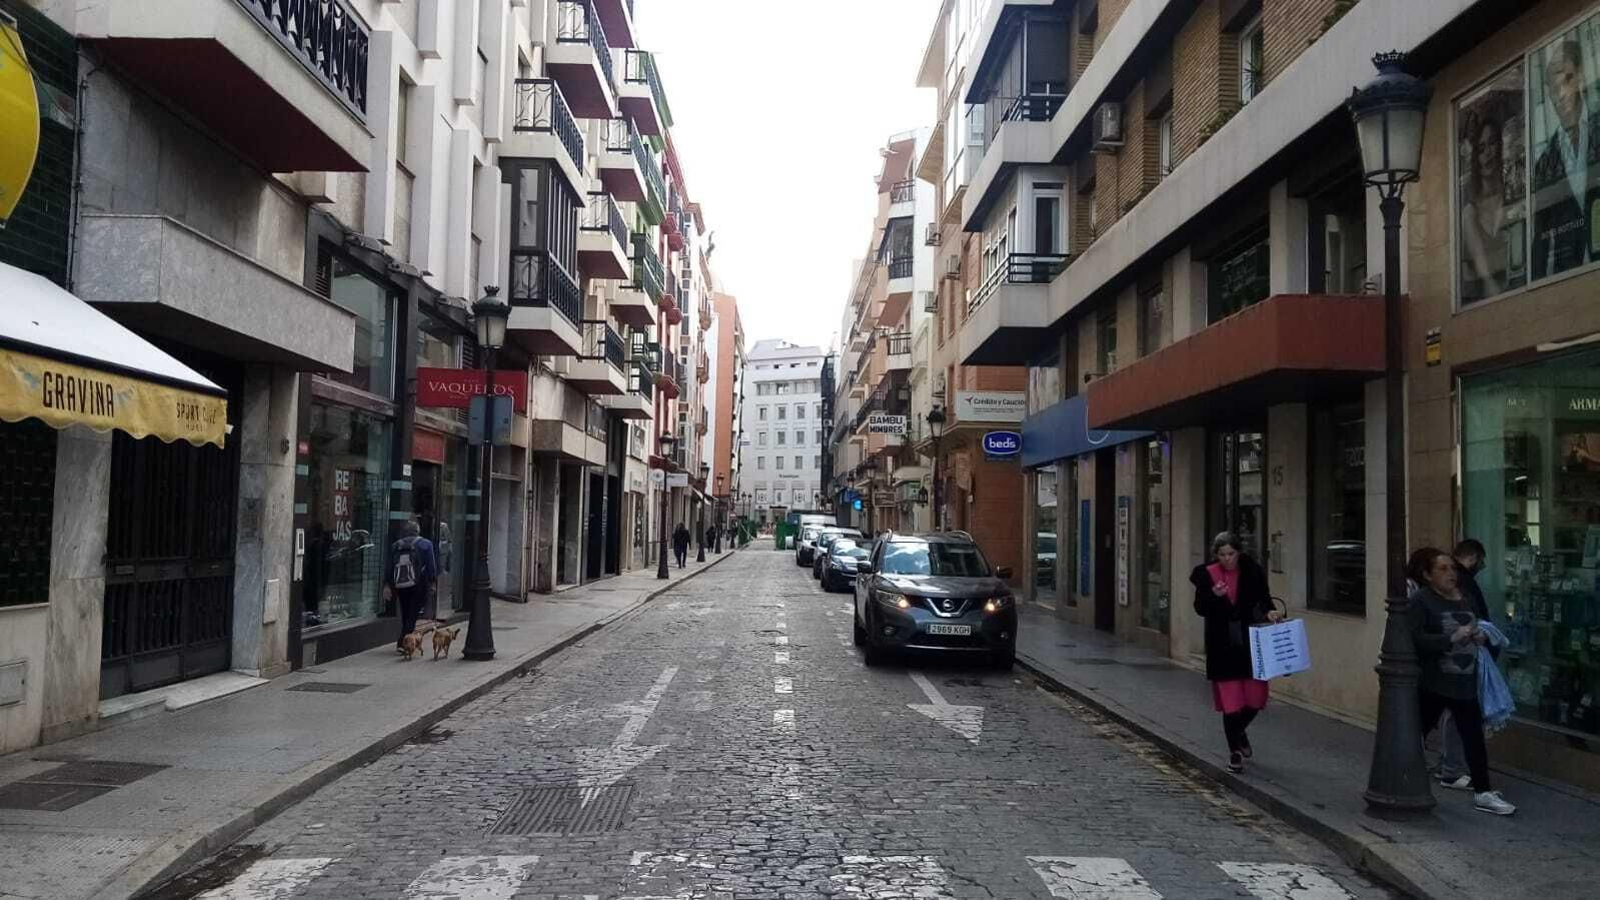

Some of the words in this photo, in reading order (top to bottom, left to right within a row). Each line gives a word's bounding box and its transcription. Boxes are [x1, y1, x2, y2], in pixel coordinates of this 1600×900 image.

[43, 371, 114, 417] GRAVINA
[869, 415, 903, 425] BAMBU
[335, 470, 350, 490] RE
[334, 495, 349, 515] BA
[332, 521, 352, 541] JAS
